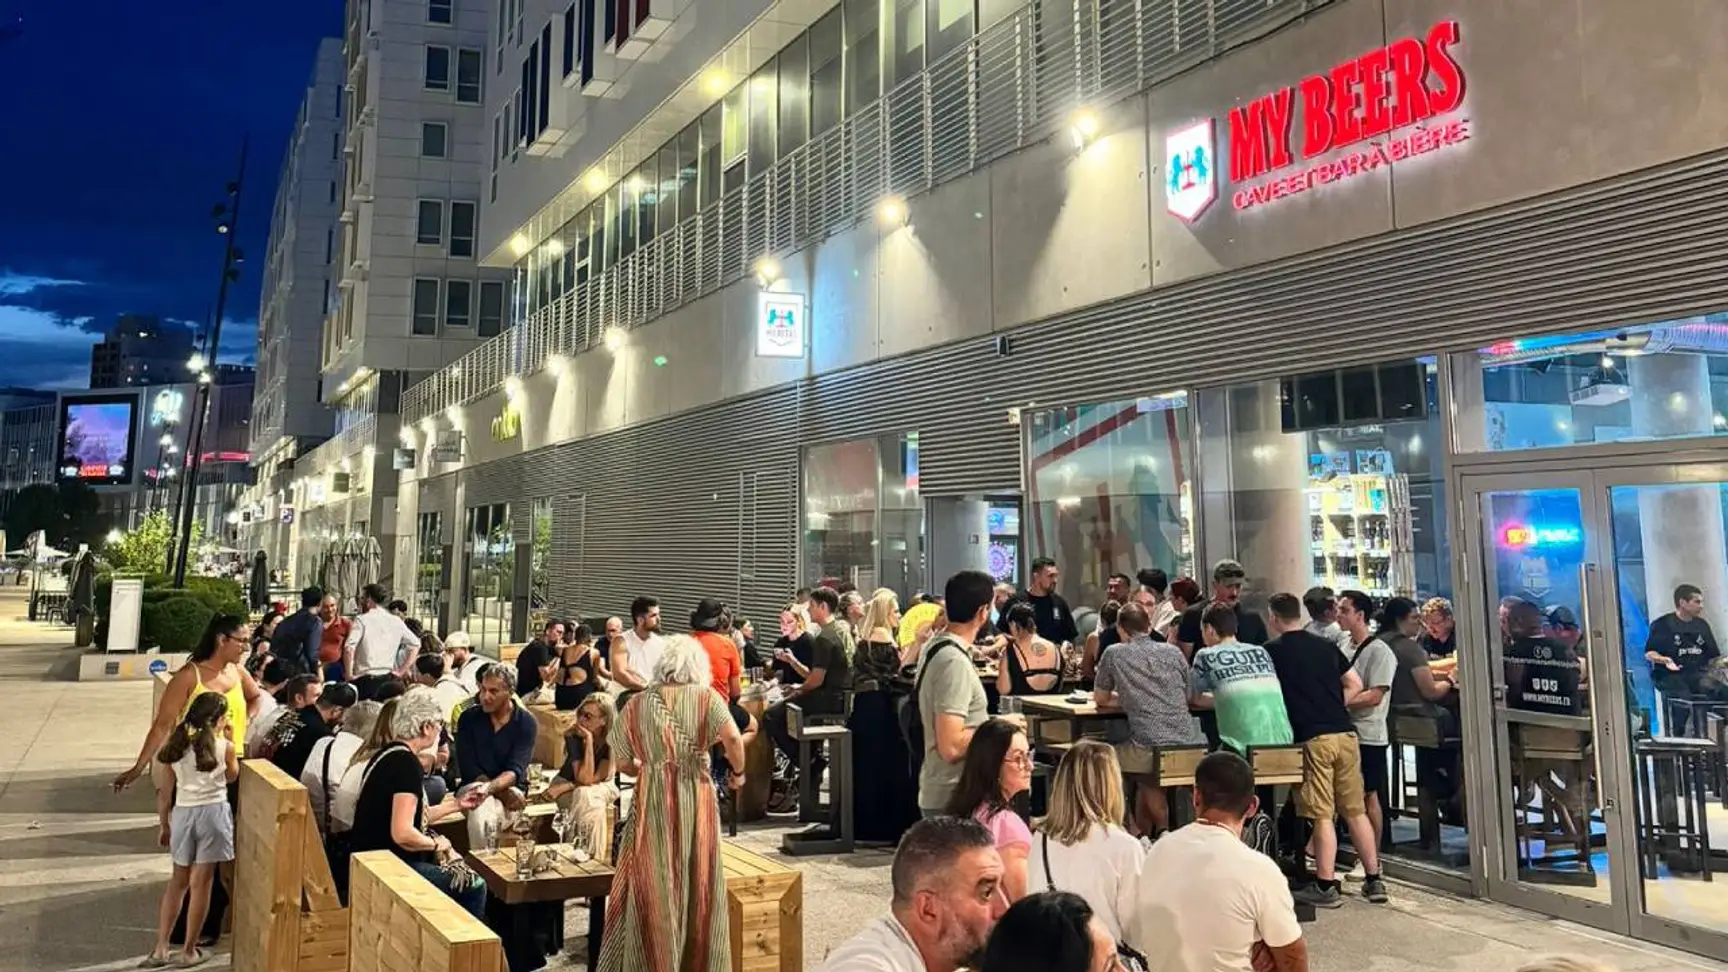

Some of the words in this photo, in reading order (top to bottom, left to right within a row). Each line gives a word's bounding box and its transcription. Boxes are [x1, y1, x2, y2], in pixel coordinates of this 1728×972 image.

[1228, 86, 1294, 184] MY
[1301, 20, 1467, 160] BEERS
[1232, 180, 1288, 210] CAVE
[1317, 152, 1368, 184] BAR
[1385, 118, 1470, 162] BIÈRE
[1194, 648, 1272, 678] McGUIR
[1214, 664, 1256, 680] IRISH
